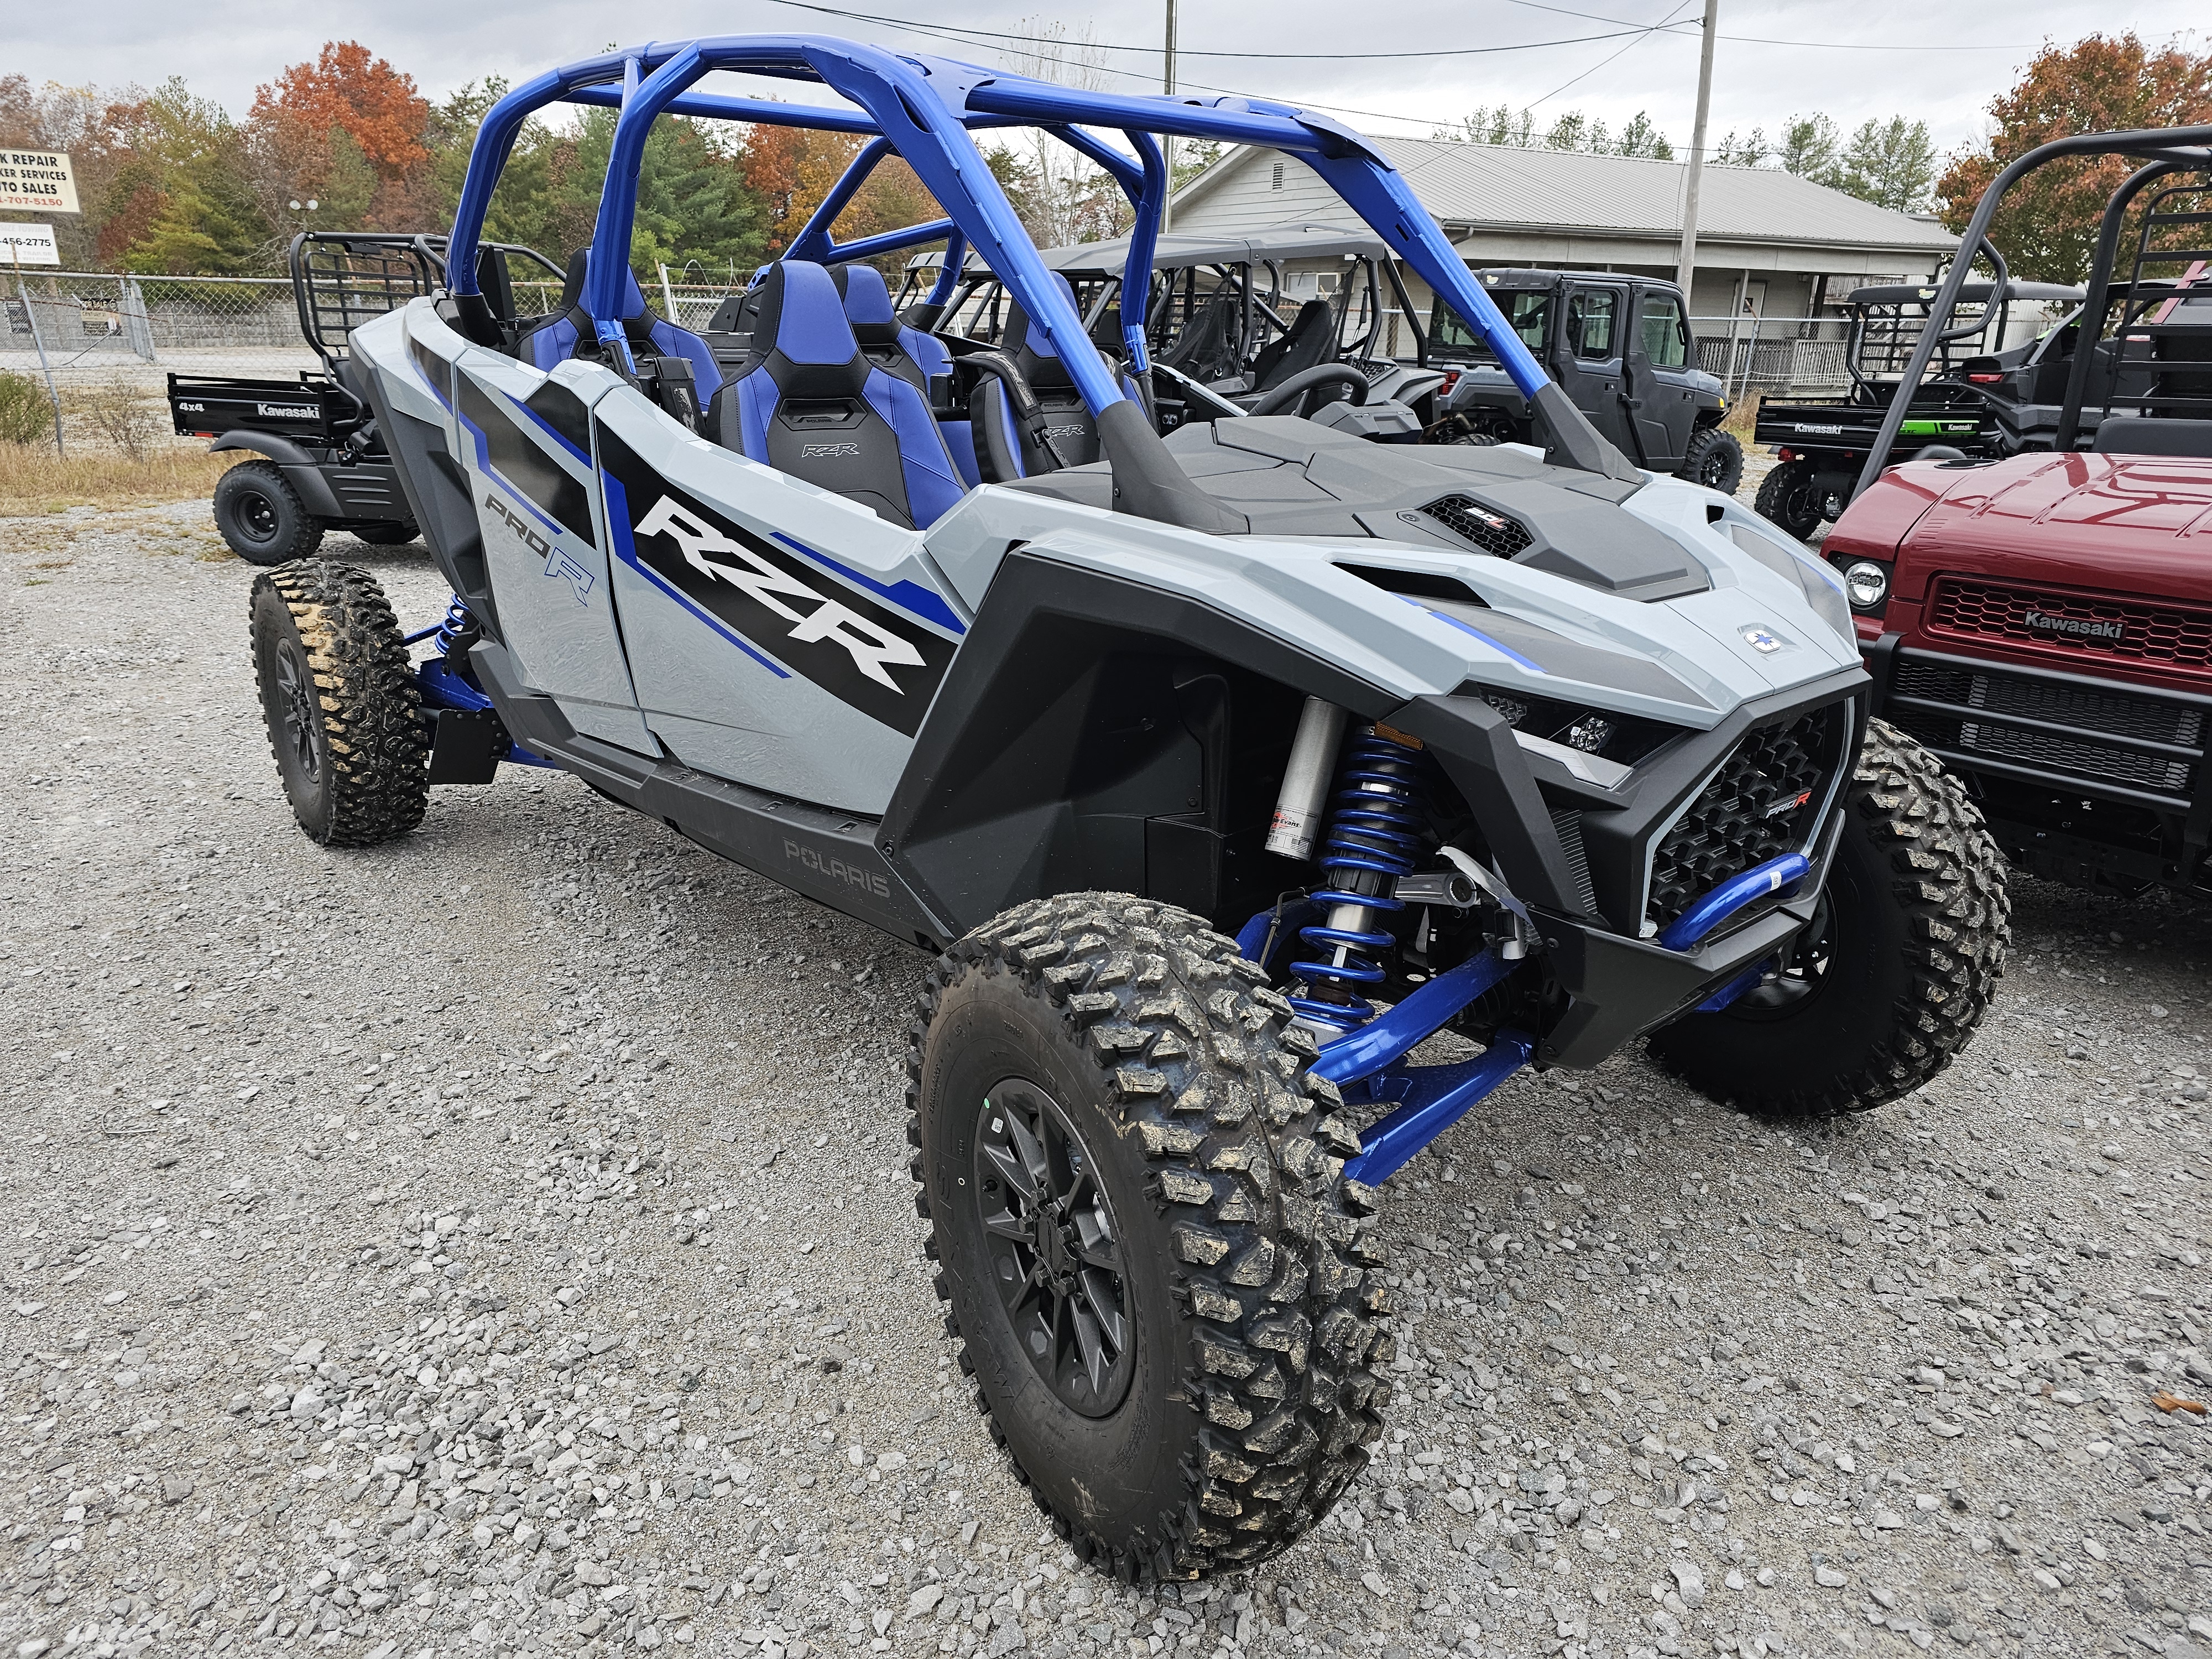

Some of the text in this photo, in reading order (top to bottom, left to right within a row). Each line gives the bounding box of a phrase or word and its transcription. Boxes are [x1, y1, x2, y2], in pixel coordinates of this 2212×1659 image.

[12, 154, 58, 167] REPAIR
[21, 169, 66, 181] SERVICES
[22, 182, 58, 195] SALES
[179, 402, 205, 412] 4x4
[257, 404, 320, 419] Kawasaki
[1794, 423, 1843, 435] Kawasaki
[801, 442, 860, 458] RZR
[484, 493, 595, 608] PRO R
[634, 494, 927, 696] RZR
[2025, 611, 2123, 639] Kawasaki
[1280, 819, 1300, 827] Evans
[783, 837, 891, 899] POLARIS
